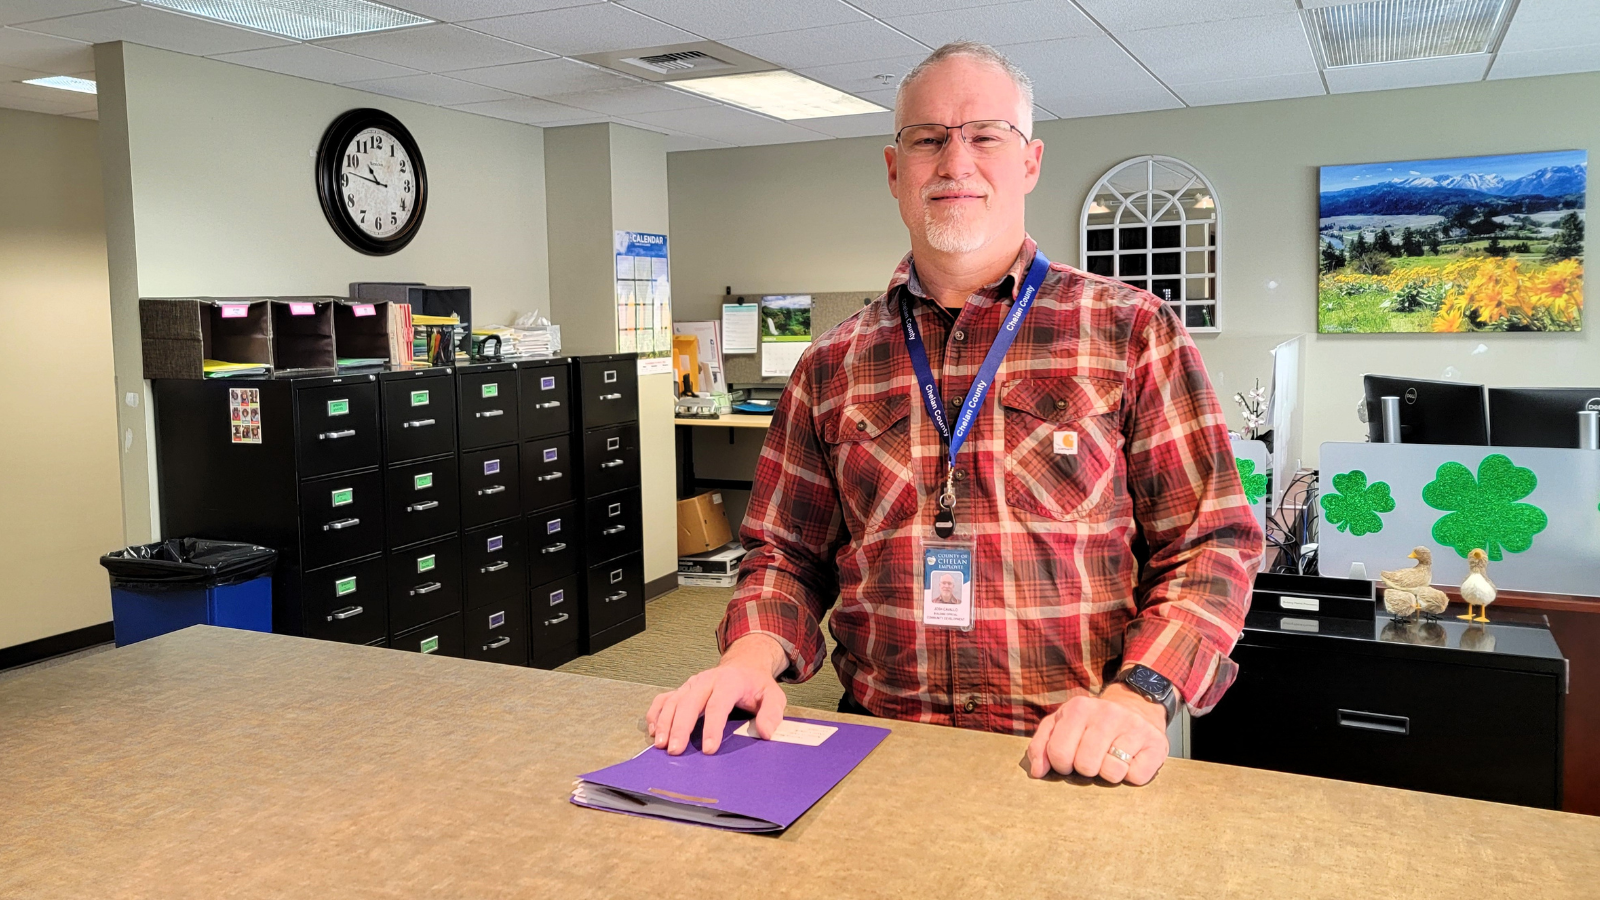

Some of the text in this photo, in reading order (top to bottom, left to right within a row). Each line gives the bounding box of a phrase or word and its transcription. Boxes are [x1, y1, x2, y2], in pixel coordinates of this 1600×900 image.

[356, 139, 369, 154] 11
[369, 135, 383, 150] 12
[390, 144, 395, 157] 1
[346, 154, 360, 169] 10
[399, 160, 406, 173] 2
[341, 173, 349, 188] 9
[404, 179, 411, 193] 3
[347, 193, 355, 208] 8
[400, 197, 406, 211] 4
[360, 210, 366, 223] 7
[375, 217, 382, 230] 6
[391, 212, 397, 225] 5
[632, 234, 664, 245] CALENDAR
[1006, 285, 1036, 331] Chelan County
[905, 317, 916, 340] County
[925, 384, 949, 437] Chelan County
[956, 379, 988, 437] Chelan County
